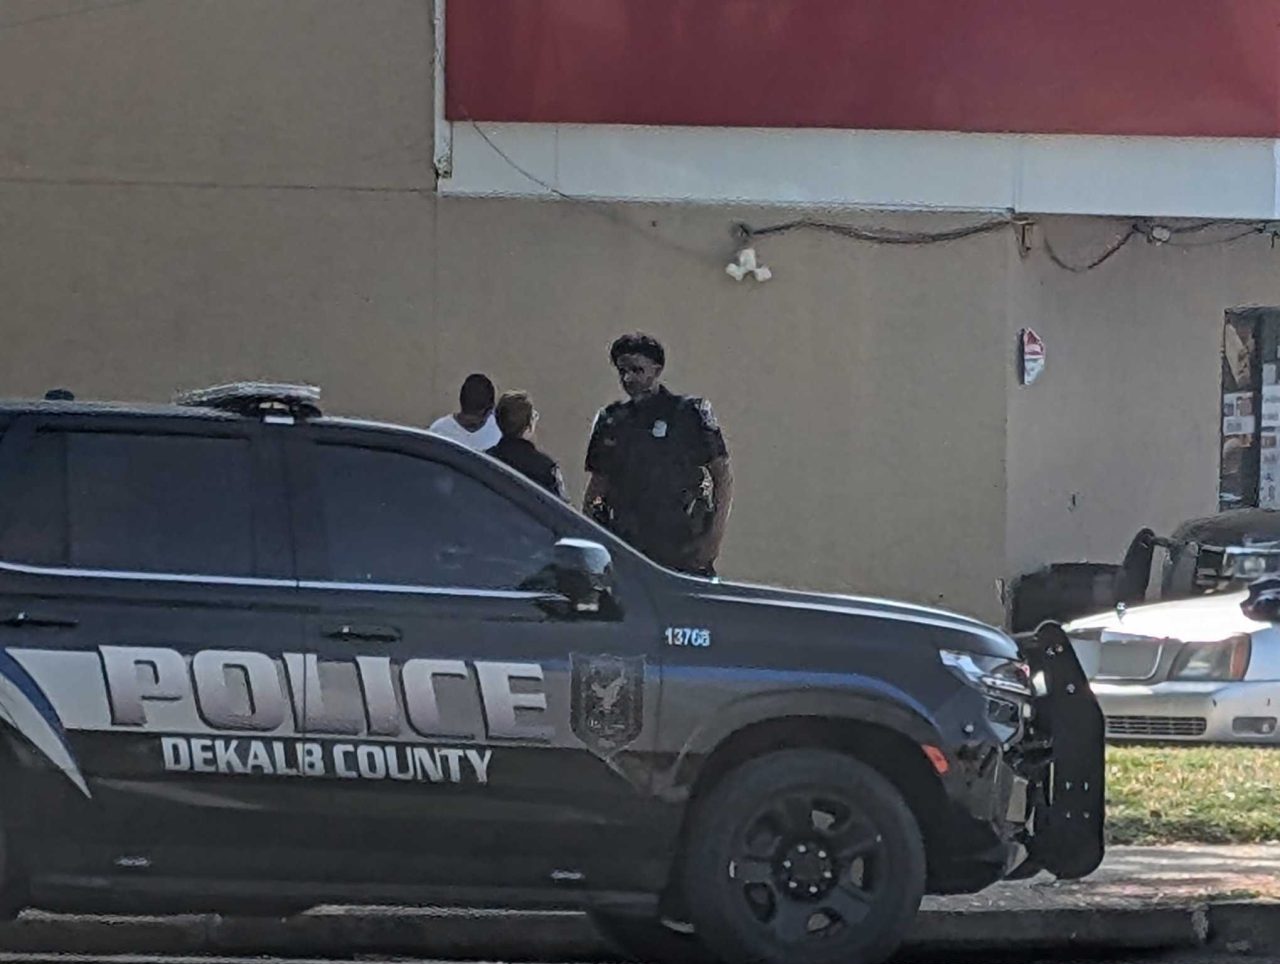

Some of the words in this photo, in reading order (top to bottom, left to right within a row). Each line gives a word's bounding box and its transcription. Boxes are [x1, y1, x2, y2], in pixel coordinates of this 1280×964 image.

[99, 645, 556, 740] POLICE
[161, 736, 325, 777] DEKALB
[332, 744, 492, 783] COUNTY
